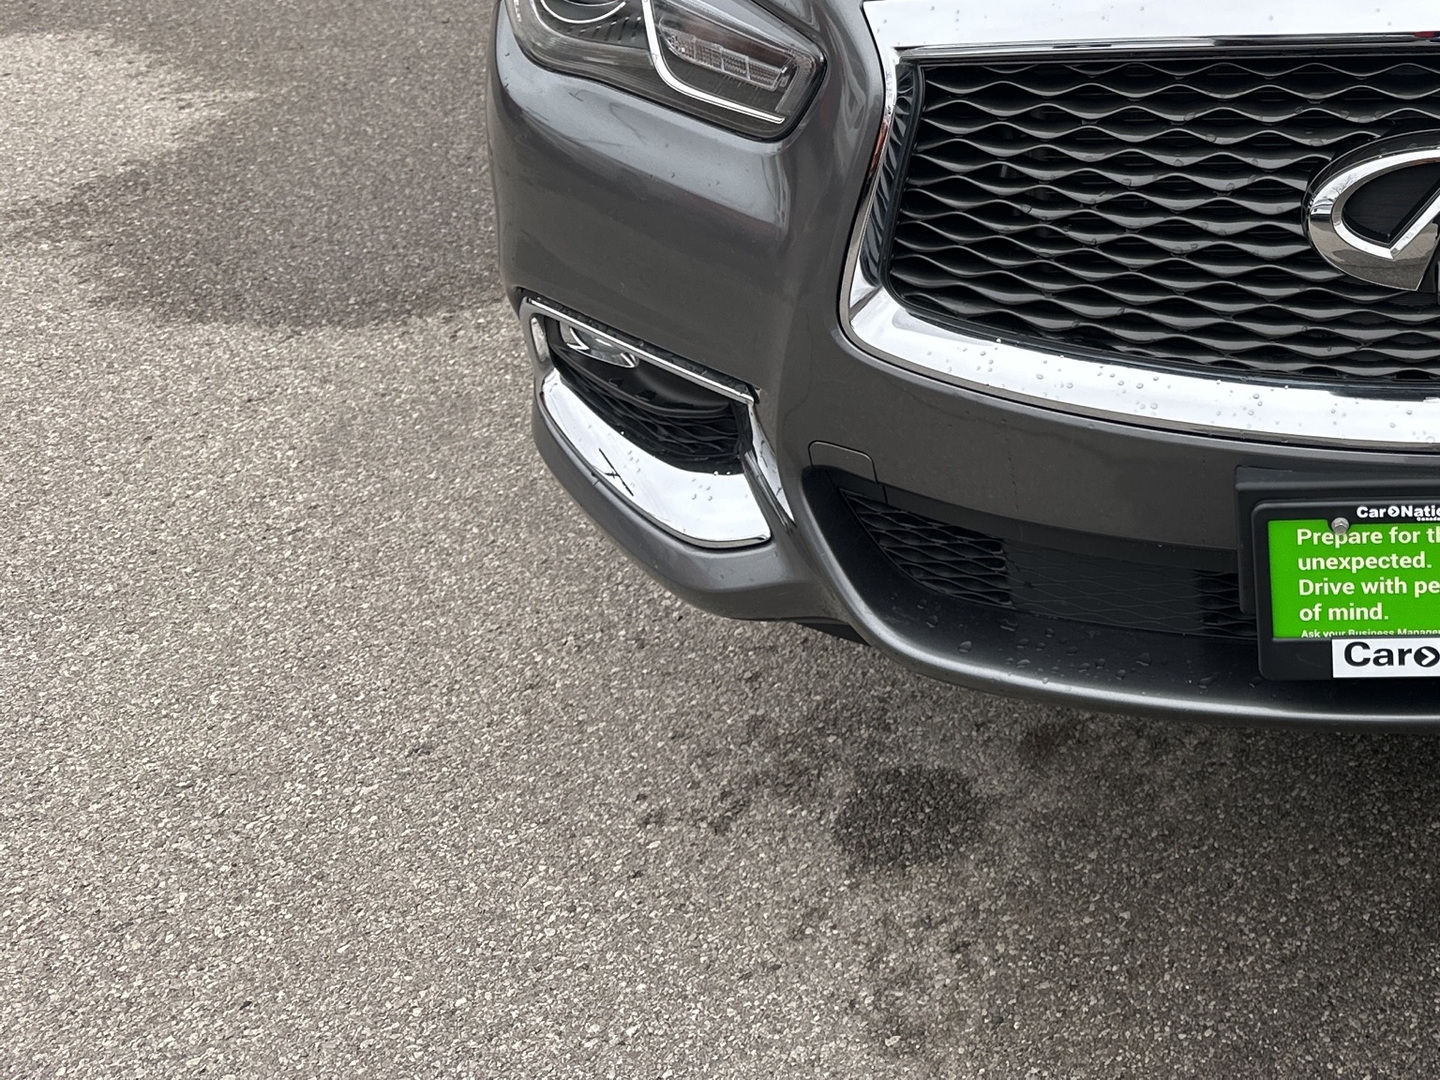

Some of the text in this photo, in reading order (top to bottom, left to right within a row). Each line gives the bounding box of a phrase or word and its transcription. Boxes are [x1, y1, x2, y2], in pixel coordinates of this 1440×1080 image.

[1296, 528, 1383, 549] Prepare
[1388, 526, 1421, 544] for
[1298, 551, 1432, 574] unexpected.
[1298, 578, 1355, 596] Drive
[1361, 576, 1408, 594] with
[1299, 602, 1389, 621] of mind.
[1301, 629, 1320, 638] Ask
